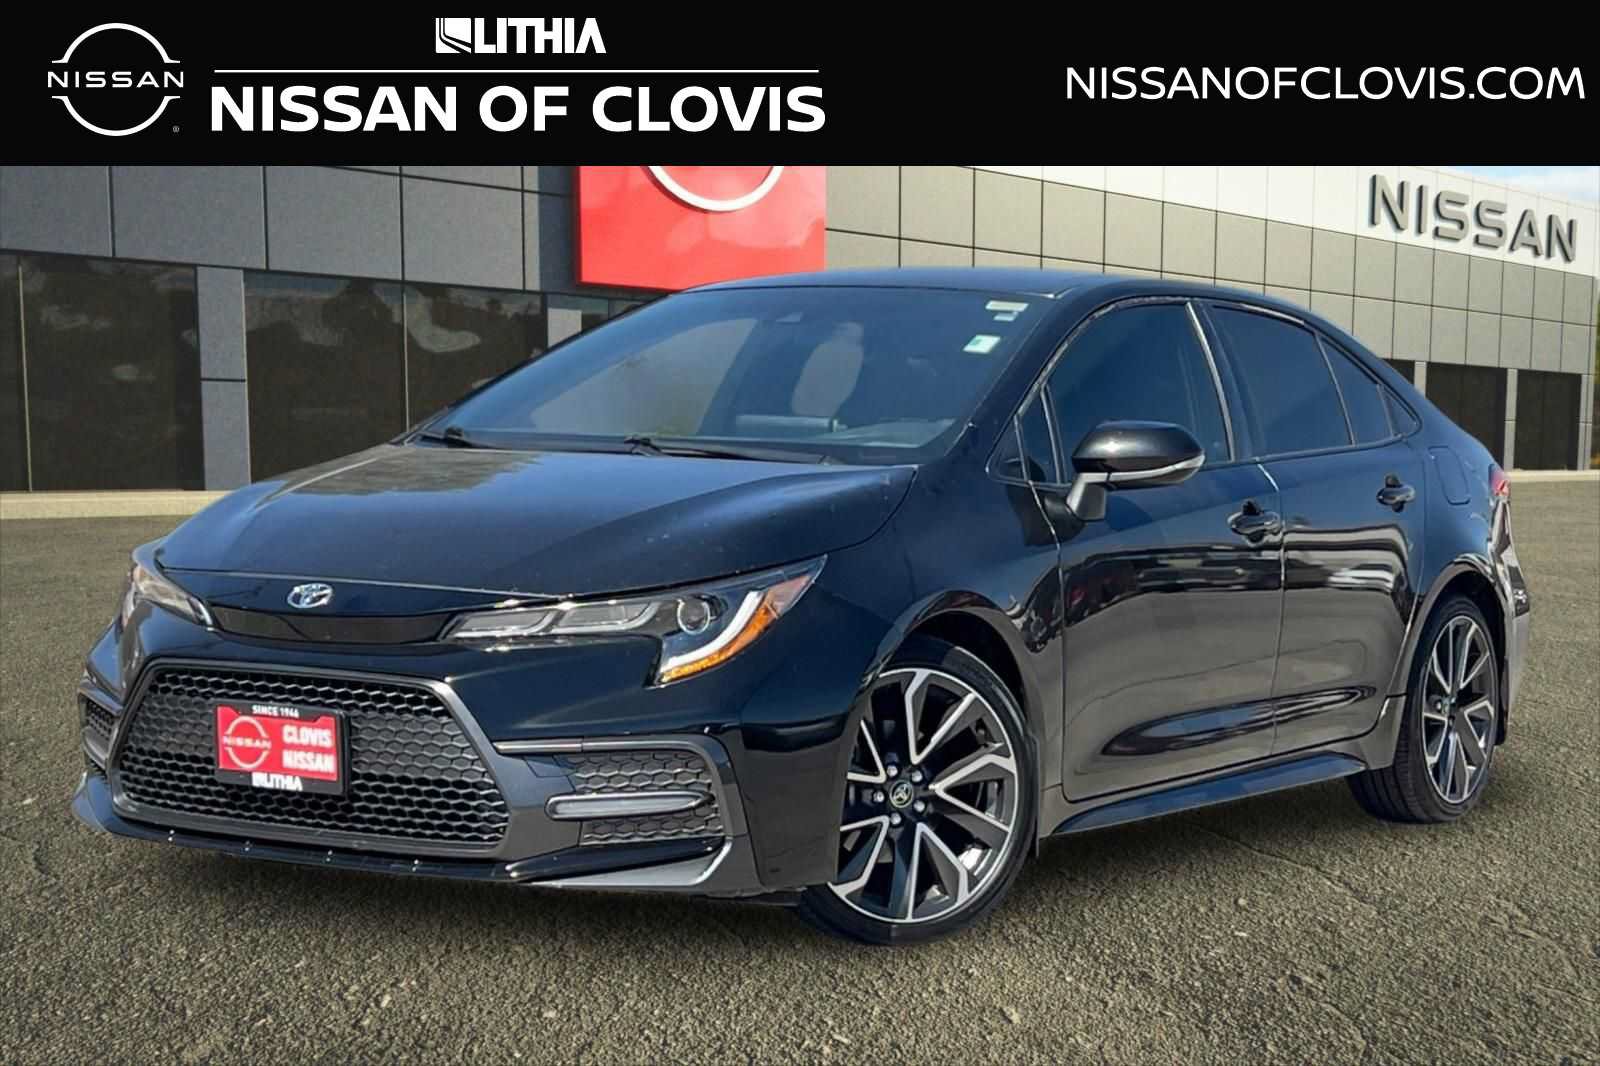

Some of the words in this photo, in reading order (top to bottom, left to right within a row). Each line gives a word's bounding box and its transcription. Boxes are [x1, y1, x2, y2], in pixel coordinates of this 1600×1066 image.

[1368, 174, 1578, 262] NISSAN
[252, 704, 279, 716] SINCE
[282, 724, 332, 748] CLOVIS
[282, 749, 337, 773] NISSAN
[263, 773, 303, 792] LITHIA
